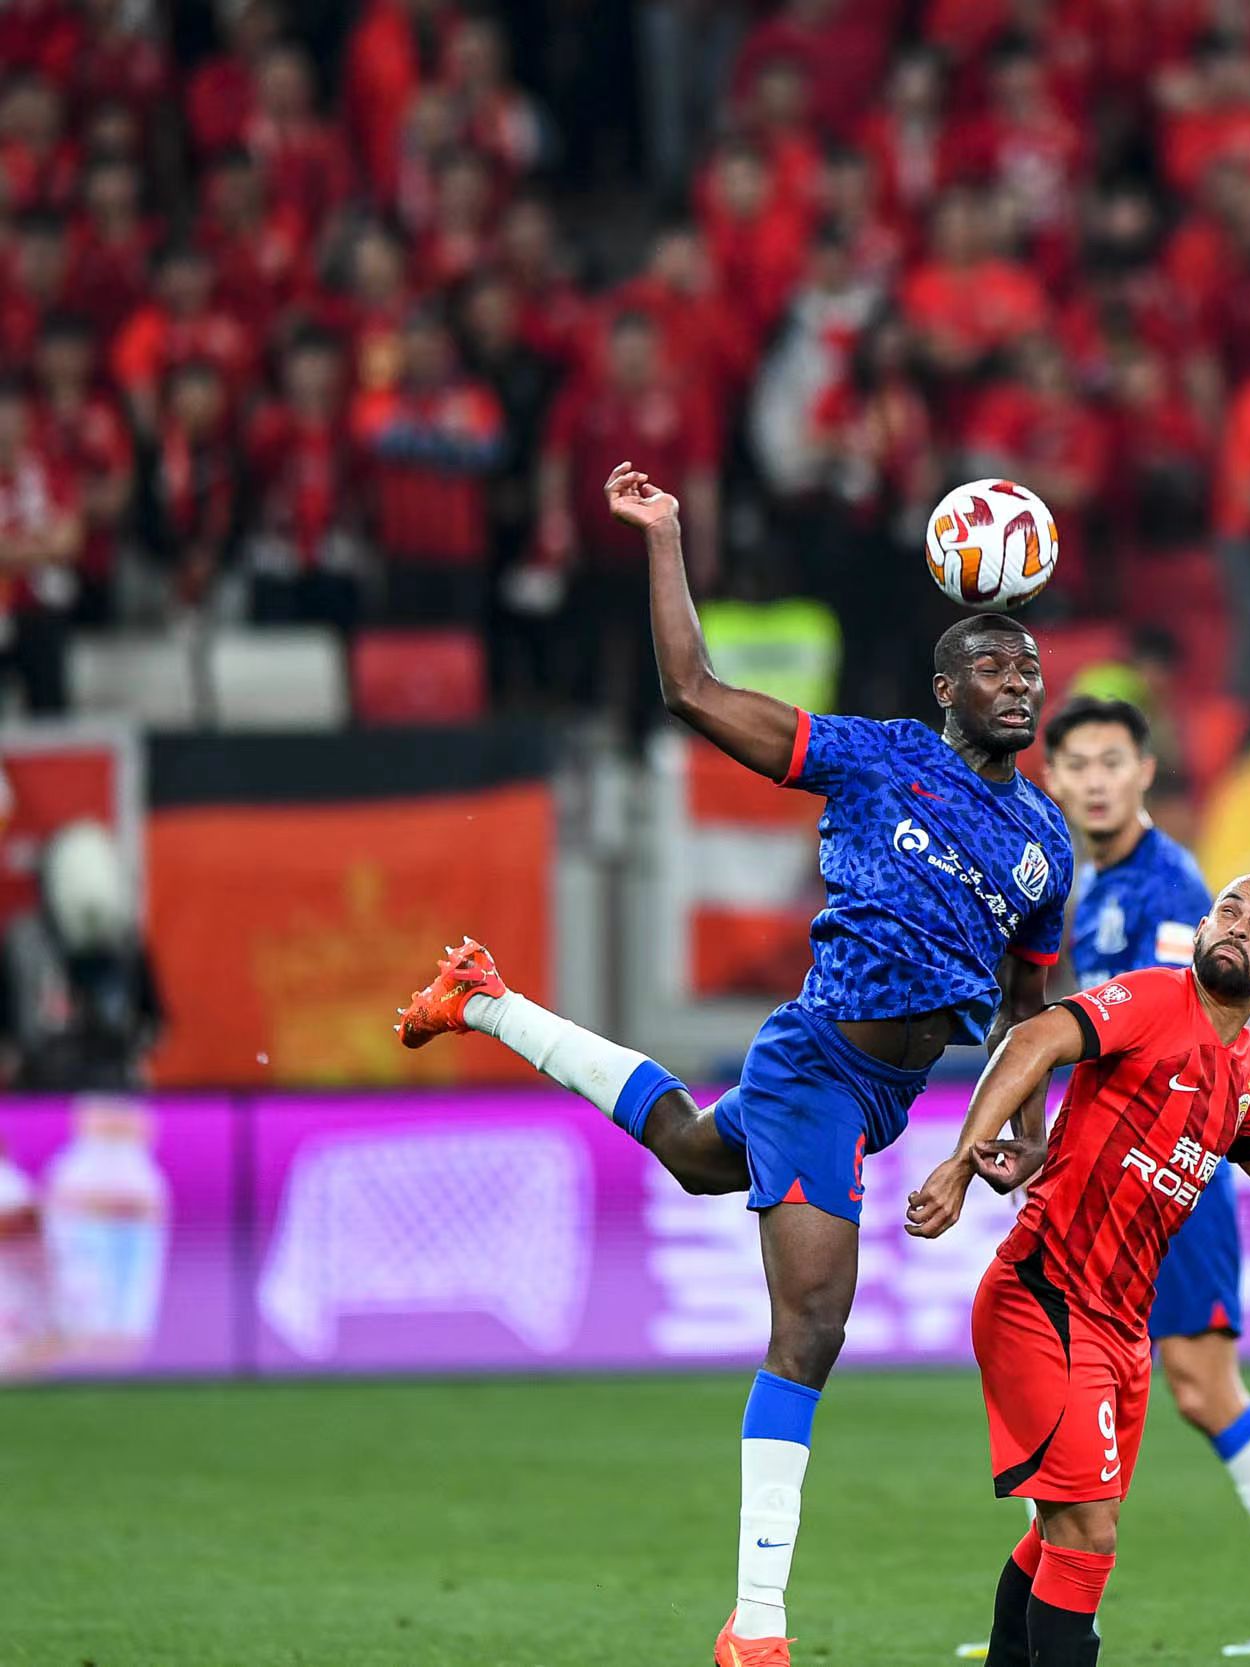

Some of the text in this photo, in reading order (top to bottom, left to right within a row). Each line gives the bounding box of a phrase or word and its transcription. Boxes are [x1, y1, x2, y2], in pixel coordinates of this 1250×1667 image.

[928, 854, 957, 877] BANK
[1121, 1147, 1200, 1211] ROE
[1098, 1400, 1118, 1462] 9
